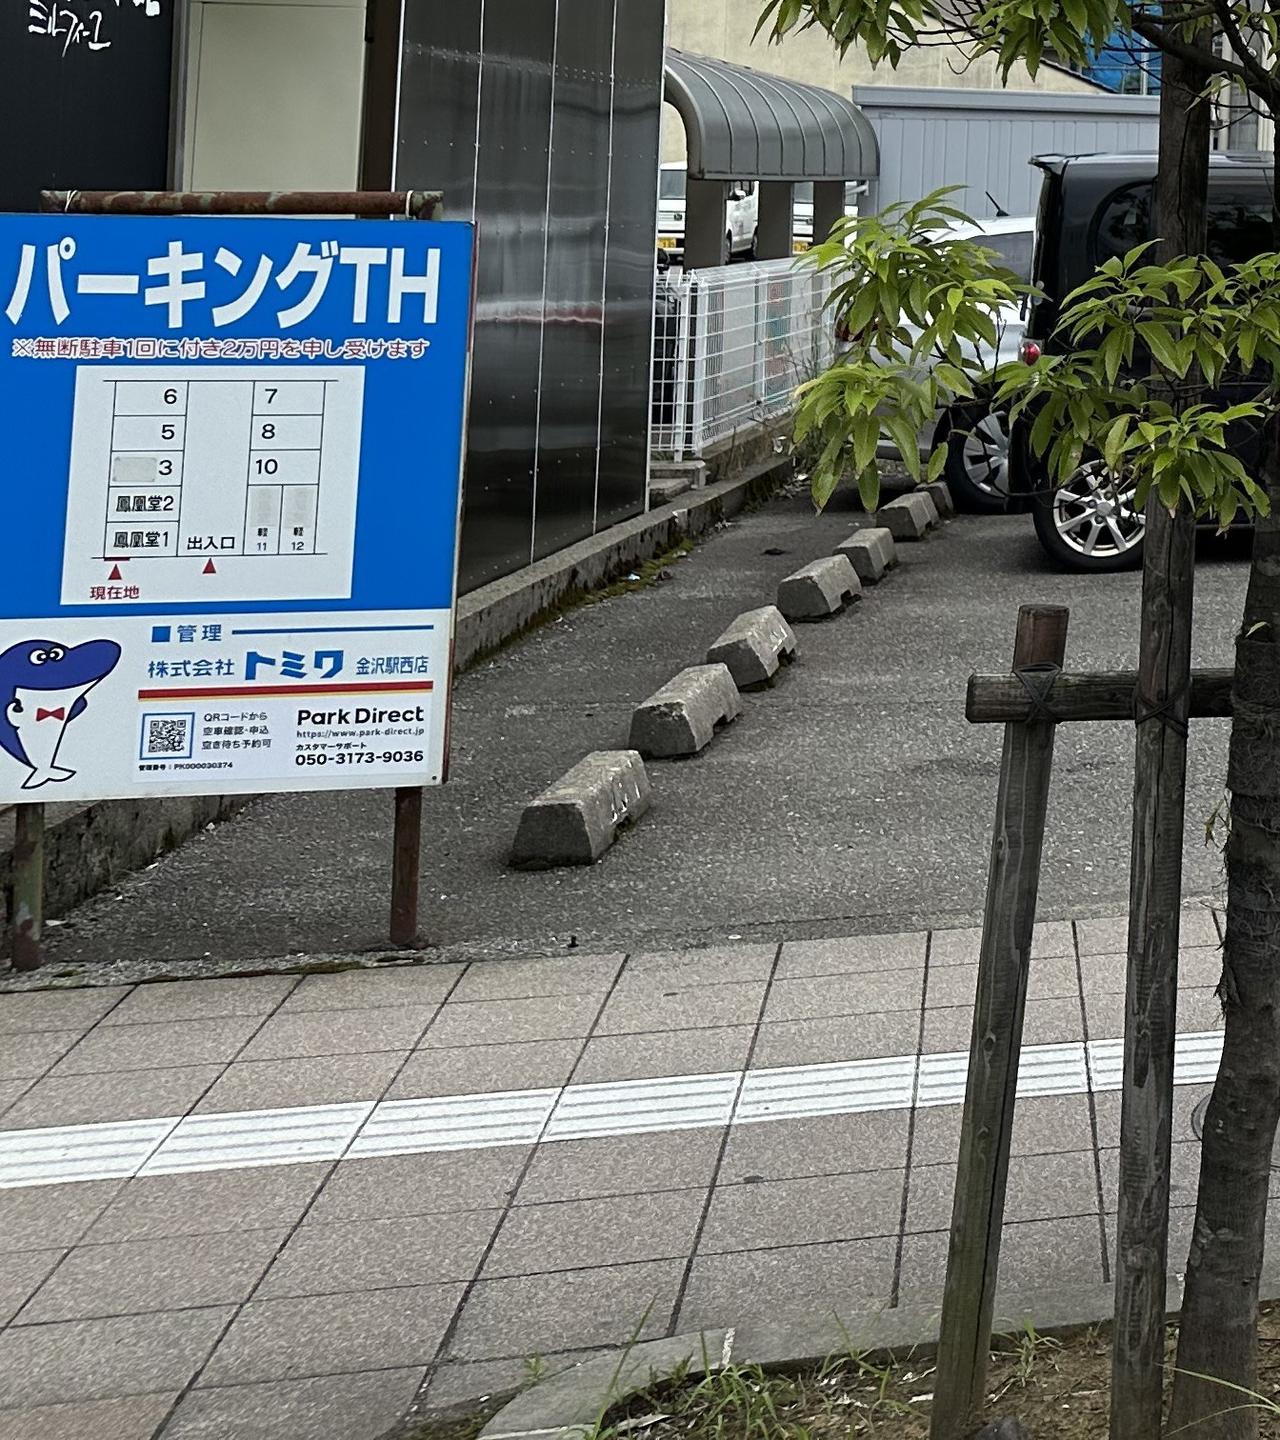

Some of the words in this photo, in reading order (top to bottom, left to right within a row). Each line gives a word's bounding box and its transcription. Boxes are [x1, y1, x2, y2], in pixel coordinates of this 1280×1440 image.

[5, 236, 441, 329] パーキングTH
[163, 388, 178, 404] 6
[264, 388, 278, 404] 7
[161, 424, 175, 440] 5
[261, 423, 276, 439] 8
[158, 460, 173, 476] 3
[255, 459, 278, 475] 10
[186, 536, 236, 551] 出入口
[256, 542, 267, 551] 11
[291, 541, 305, 551] 12
[89, 585, 140, 601] 現在地
[176, 624, 223, 643] 管理
[148, 659, 235, 679] 株式会社
[244, 649, 344, 681] トミワ
[355, 655, 429, 676] 金沢駅西店
[297, 708, 351, 726] Park
[354, 706, 425, 724] Direct
[295, 741, 367, 752] カスタマーサポート
[295, 750, 425, 766] 050-3173-9036
